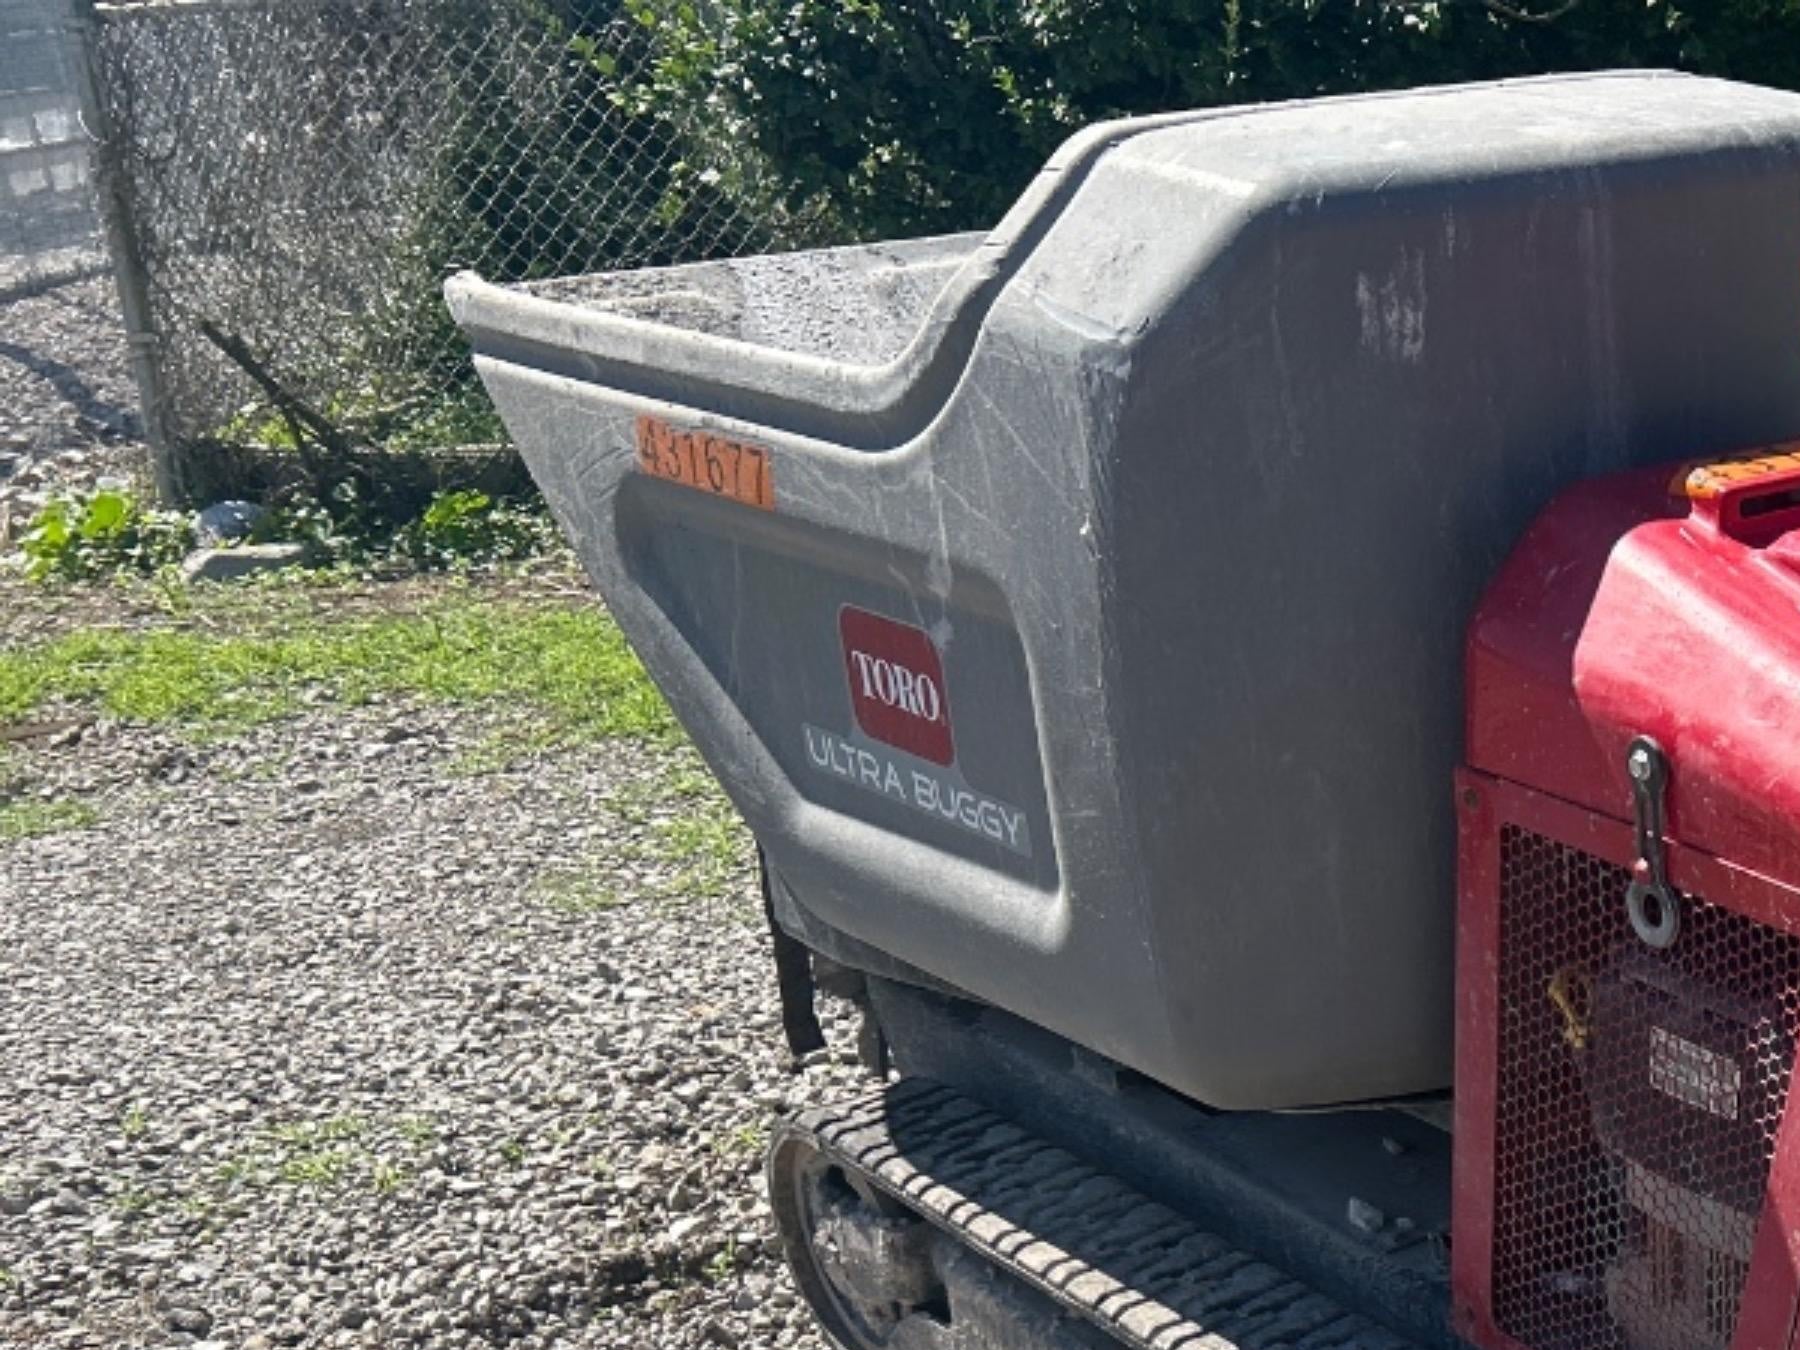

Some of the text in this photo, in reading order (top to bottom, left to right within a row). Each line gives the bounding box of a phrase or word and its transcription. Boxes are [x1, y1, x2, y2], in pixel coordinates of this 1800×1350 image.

[640, 422, 765, 505] 431677
[852, 650, 938, 721] TORO
[805, 727, 1024, 846] ULTRA BUGGY
